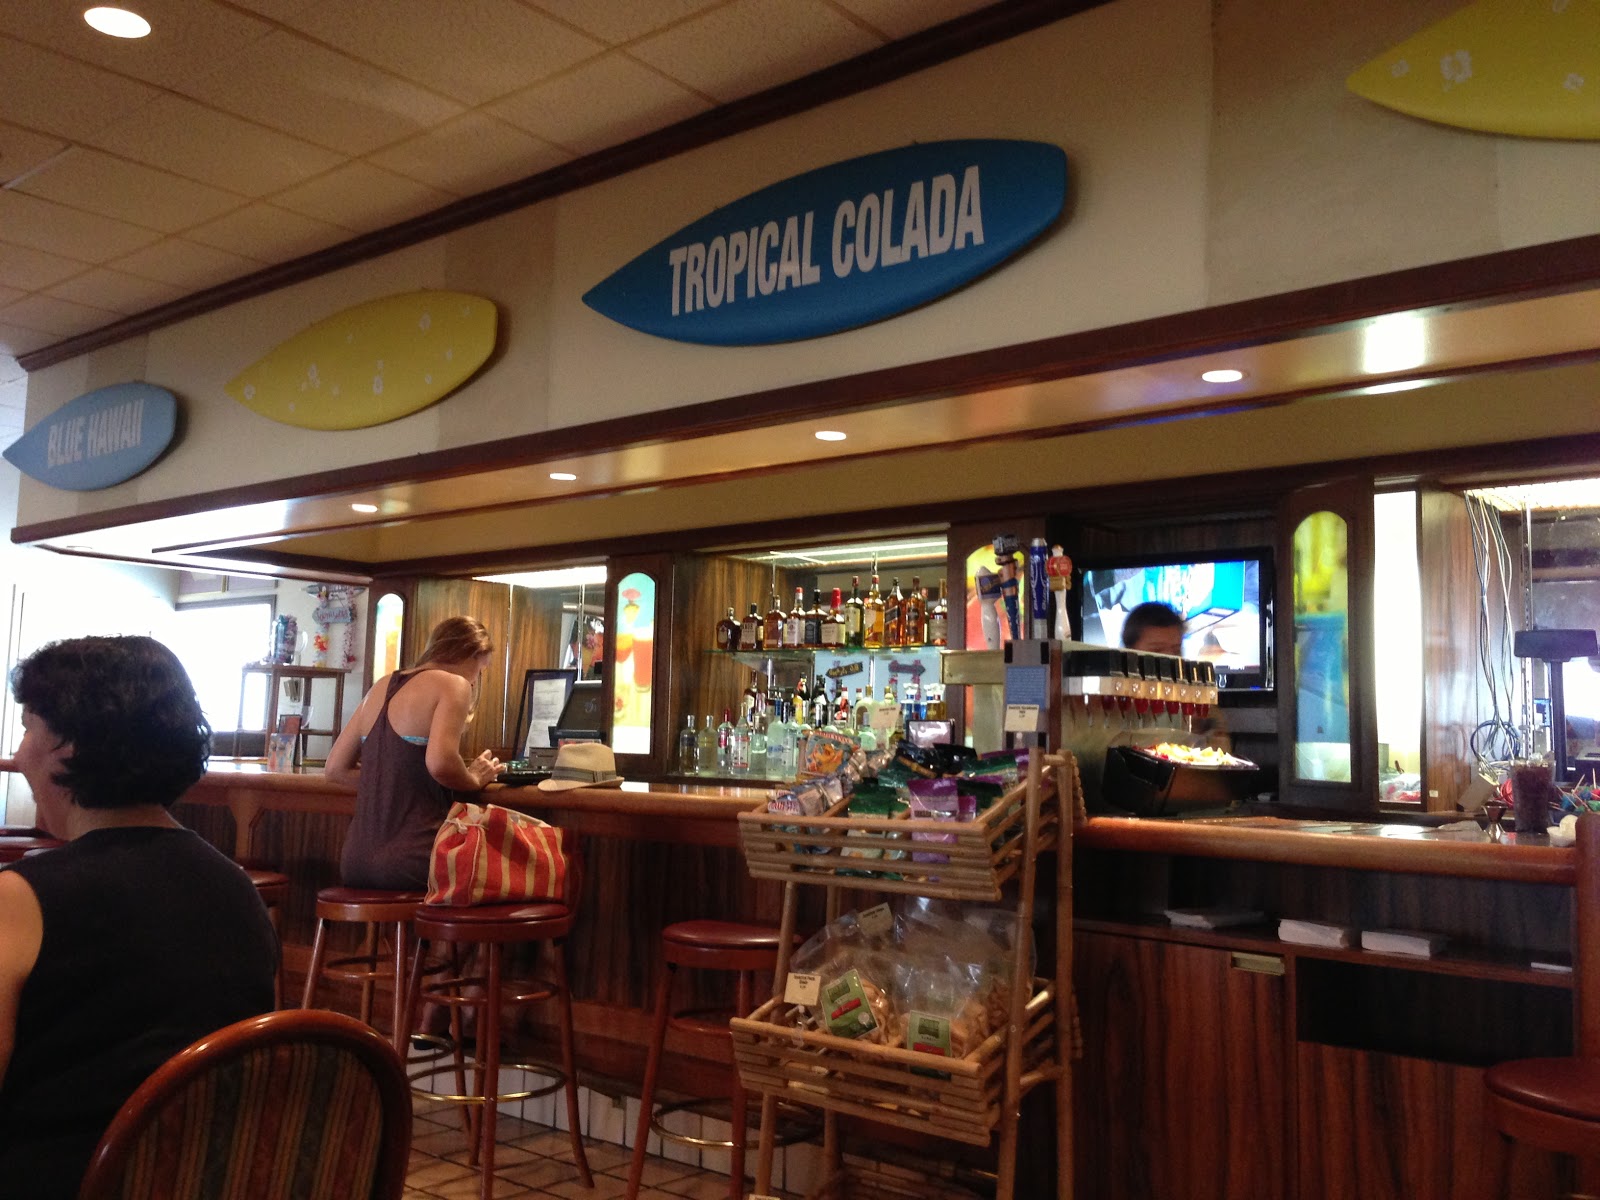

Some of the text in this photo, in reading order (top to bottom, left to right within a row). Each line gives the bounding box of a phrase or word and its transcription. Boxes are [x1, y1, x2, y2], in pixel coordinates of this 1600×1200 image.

[669, 165, 985, 317] TROPICAL COLADA
[47, 415, 86, 469] BLUE
